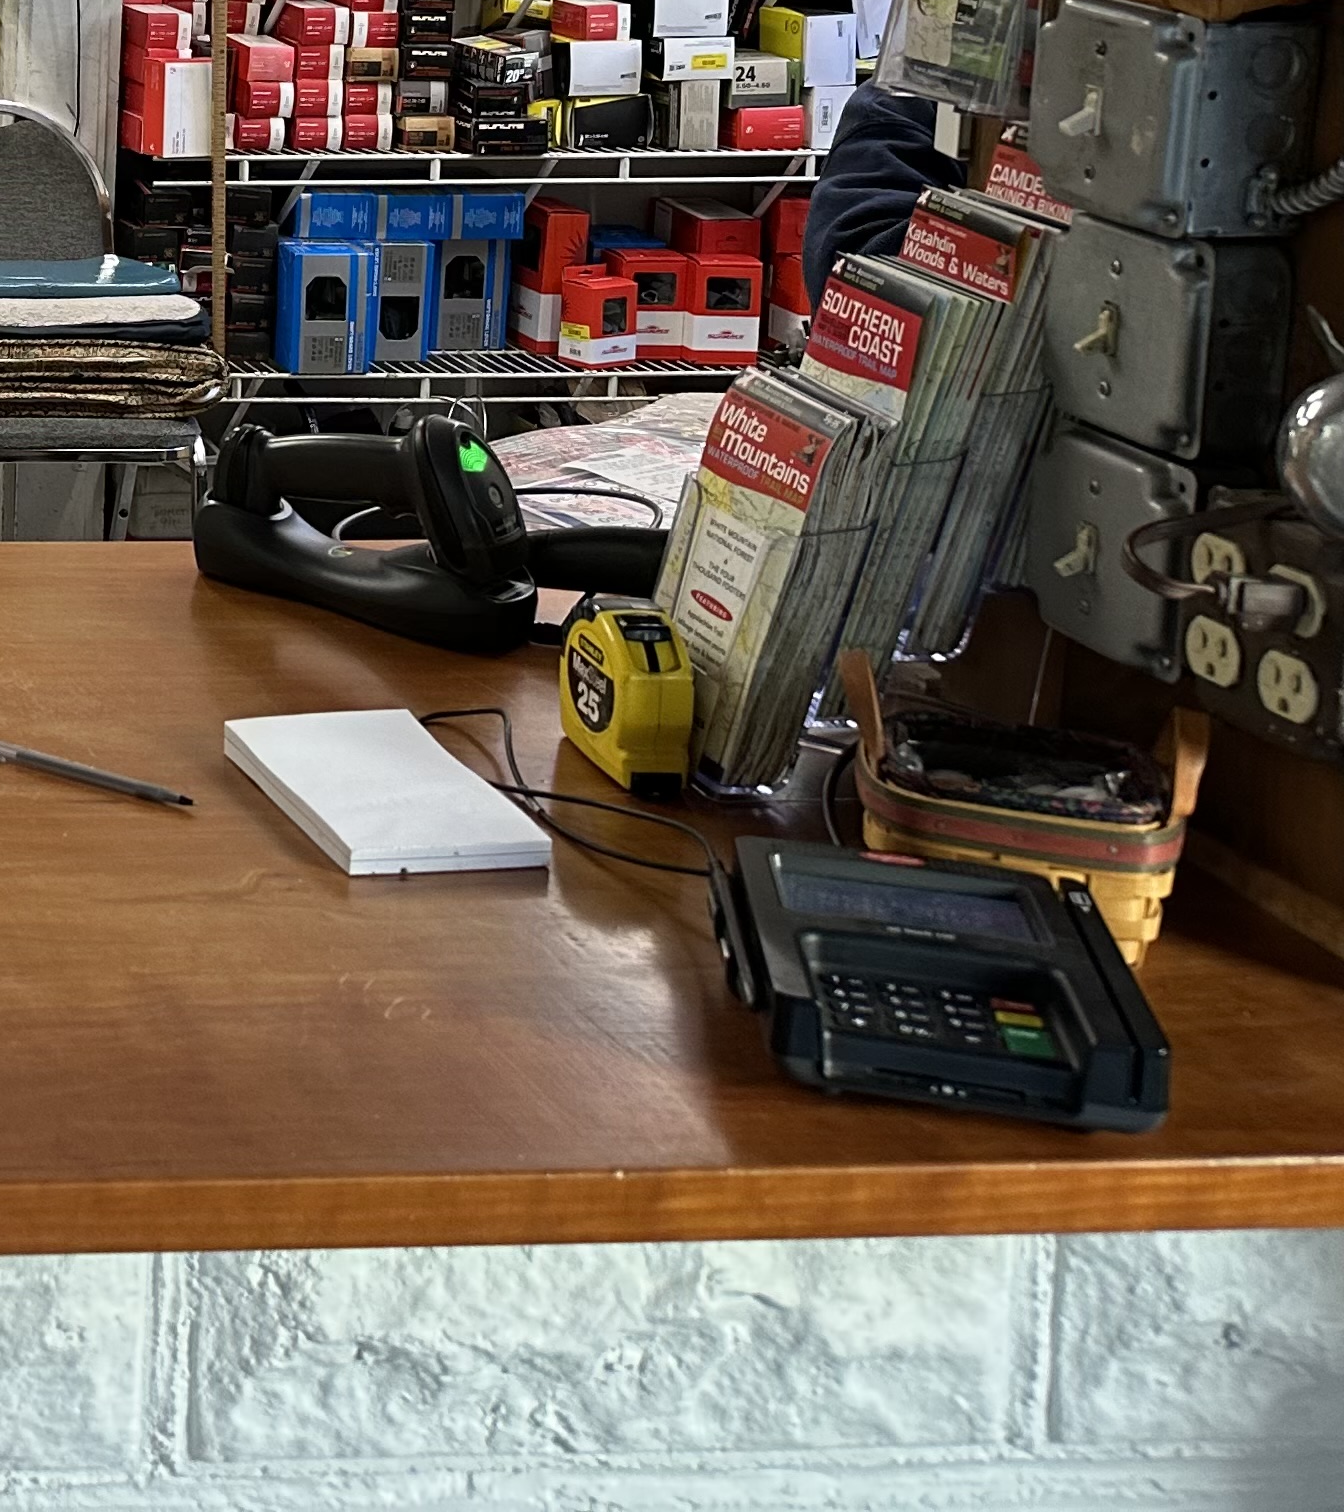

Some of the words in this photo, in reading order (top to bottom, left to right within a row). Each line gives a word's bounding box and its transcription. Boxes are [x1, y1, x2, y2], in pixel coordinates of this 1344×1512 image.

[735, 65, 756, 83] 24
[989, 163, 1048, 196] CAMDE
[905, 222, 957, 255] Katahdin
[902, 240, 946, 270] Woods
[948, 256, 959, 275] &
[962, 261, 1009, 296] Waters
[821, 288, 905, 344] SOUTHERN
[847, 325, 904, 367] COAST
[720, 400, 769, 443] White
[706, 444, 761, 481] WATERPROOF
[720, 427, 811, 496] Mountains
[577, 681, 600, 723] 25
